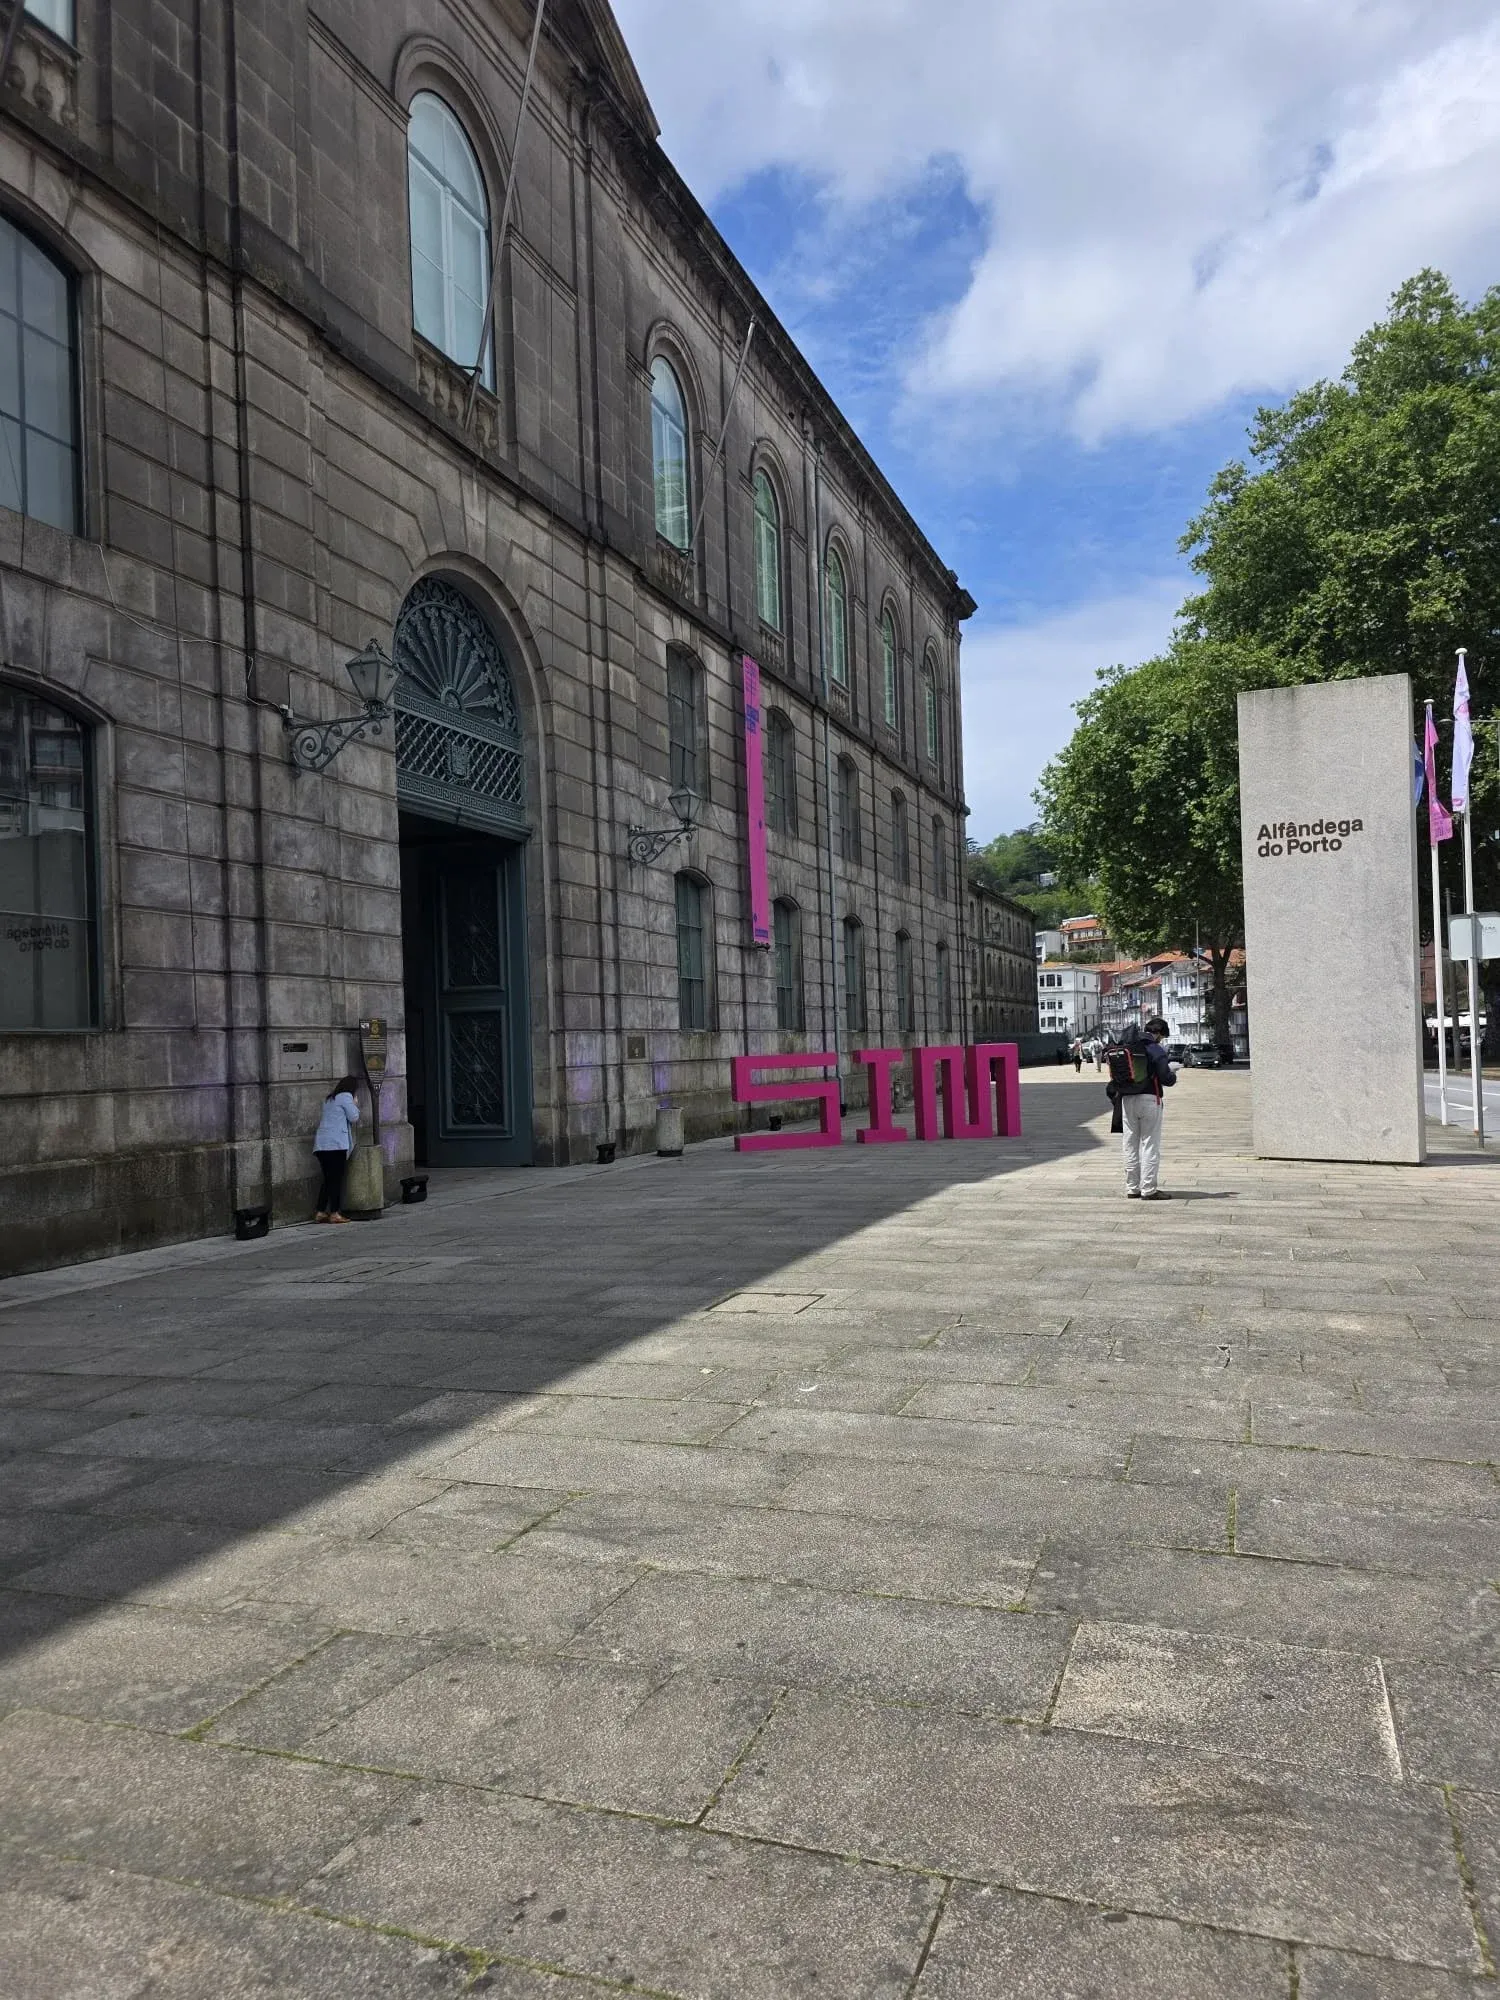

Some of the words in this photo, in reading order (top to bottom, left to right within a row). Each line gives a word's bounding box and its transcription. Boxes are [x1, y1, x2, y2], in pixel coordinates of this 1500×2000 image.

[1257, 819, 1363, 841] Alfândega
[1258, 842, 1283, 857] do
[1287, 837, 1342, 855] Porto
